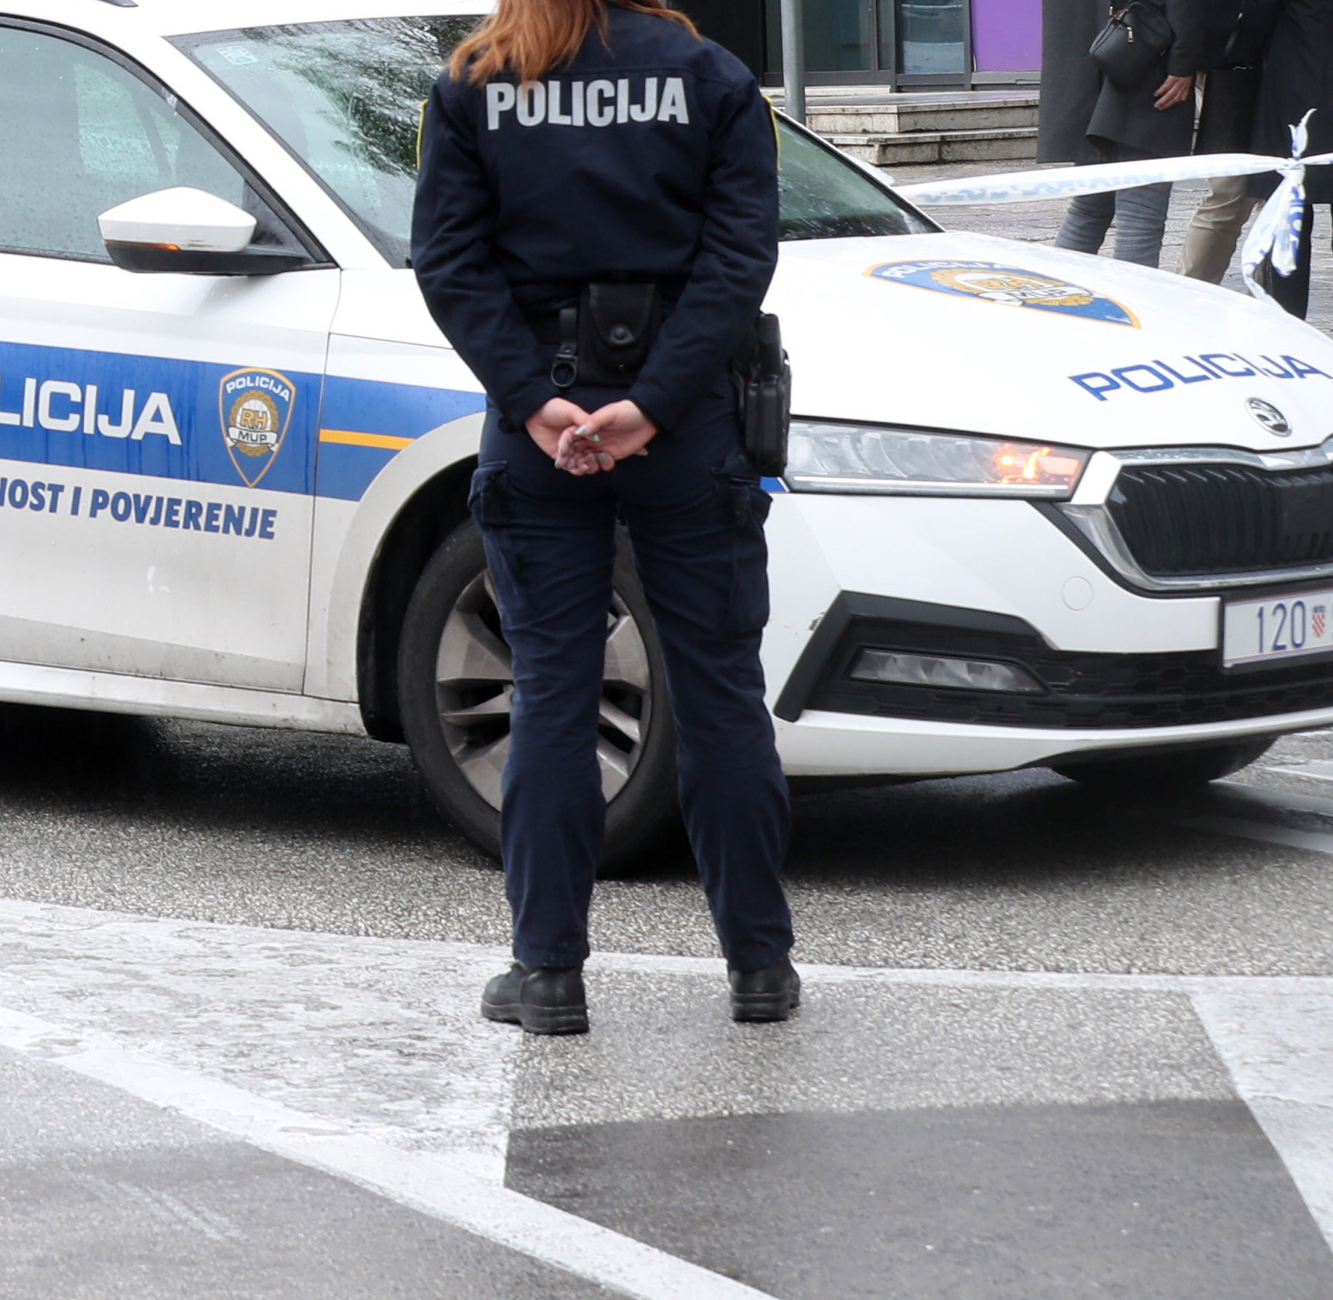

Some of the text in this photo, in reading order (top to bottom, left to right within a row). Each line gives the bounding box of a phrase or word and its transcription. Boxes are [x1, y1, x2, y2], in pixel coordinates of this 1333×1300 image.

[486, 77, 690, 130] POLICIJA
[226, 376, 290, 402] POLICIJA
[1068, 353, 1333, 402] POLICIJA
[238, 431, 267, 442] MUP
[240, 408, 267, 430] RH
[70, 486, 83, 516] I
[89, 488, 278, 540] POVJERENJE
[1257, 600, 1307, 654] 120
